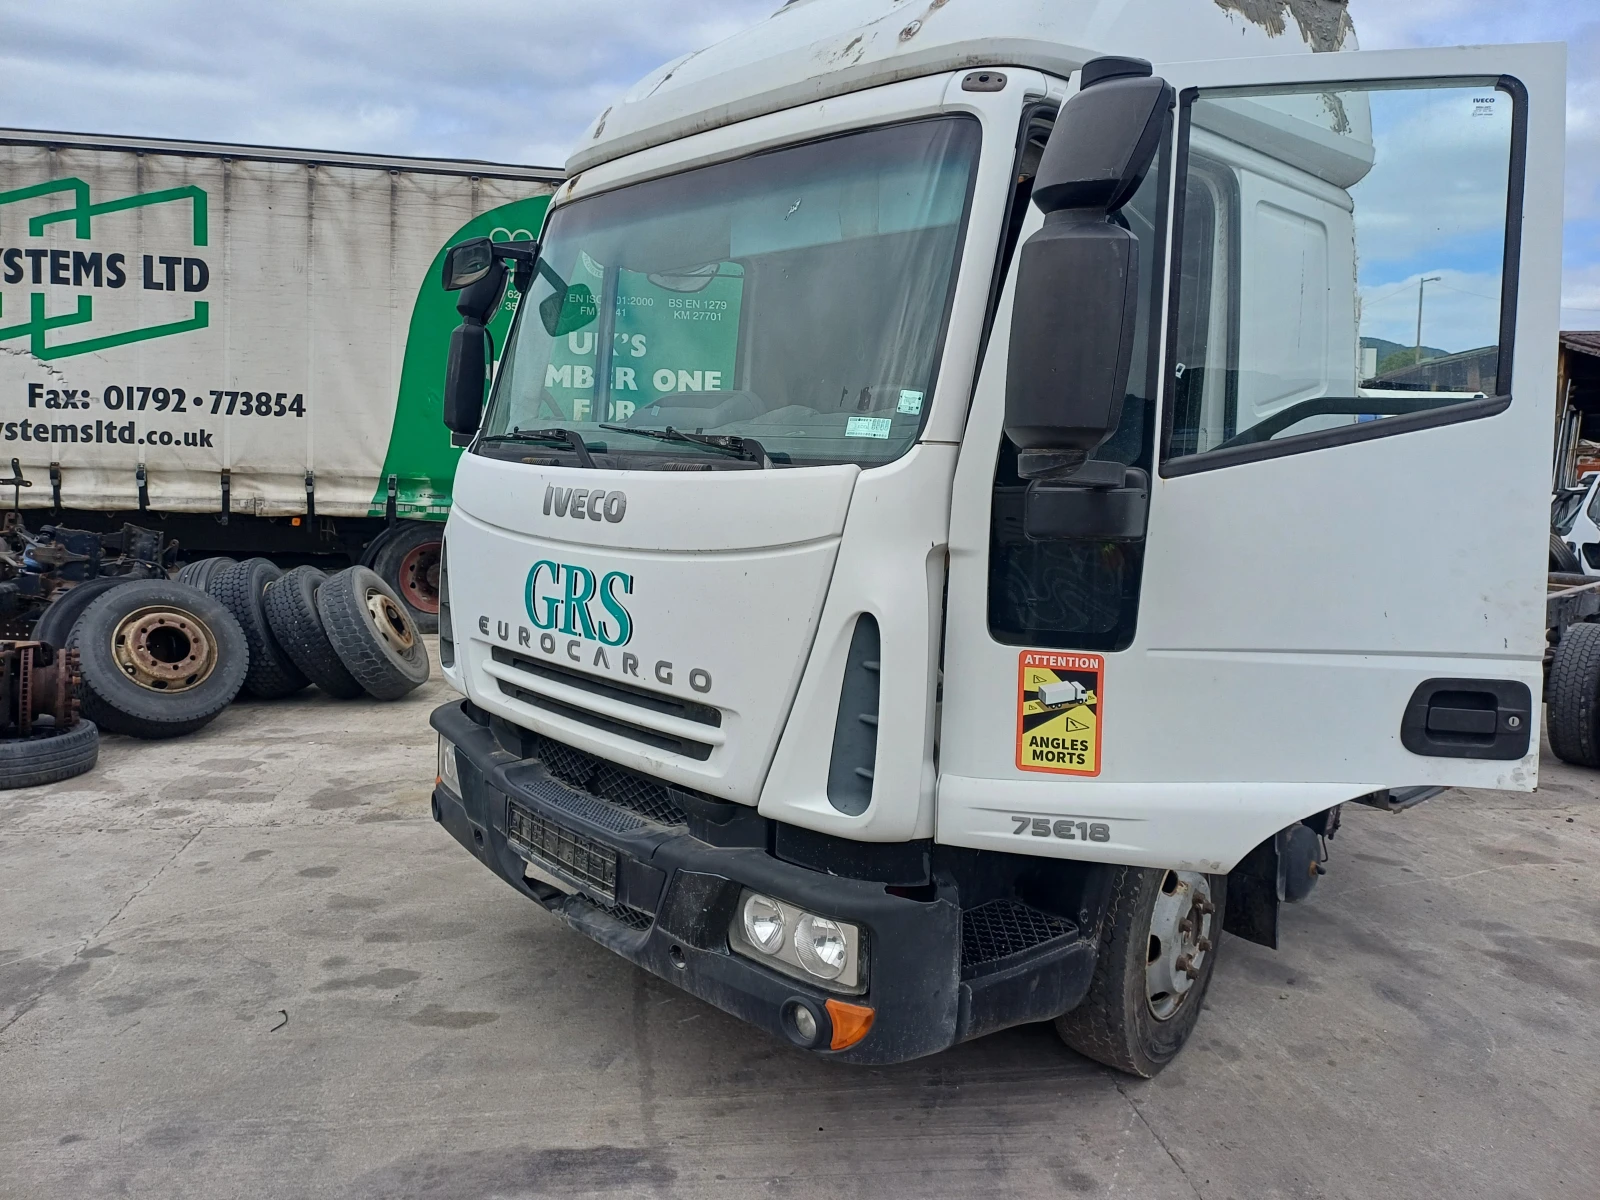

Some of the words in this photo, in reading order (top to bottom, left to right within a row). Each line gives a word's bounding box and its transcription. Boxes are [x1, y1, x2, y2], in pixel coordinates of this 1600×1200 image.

[142, 254, 210, 293] LTD
[569, 293, 584, 304] EN
[668, 298, 683, 308] BS
[685, 299, 700, 309] EN
[703, 300, 727, 310] 1279
[580, 306, 595, 316] FM
[673, 310, 690, 320] KM
[692, 311, 722, 321] 27701
[544, 364, 638, 391] MBR
[652, 368, 722, 392] ONE
[28, 382, 91, 410] Fax:
[542, 483, 627, 524] IVECO
[524, 559, 634, 647] GRS
[478, 615, 712, 694] EUROCARGO
[1024, 654, 1099, 669] ATTENTION
[1029, 735, 1089, 752] ANGLES
[1031, 749, 1086, 765] MORTS
[1011, 815, 1111, 843] 75E18
